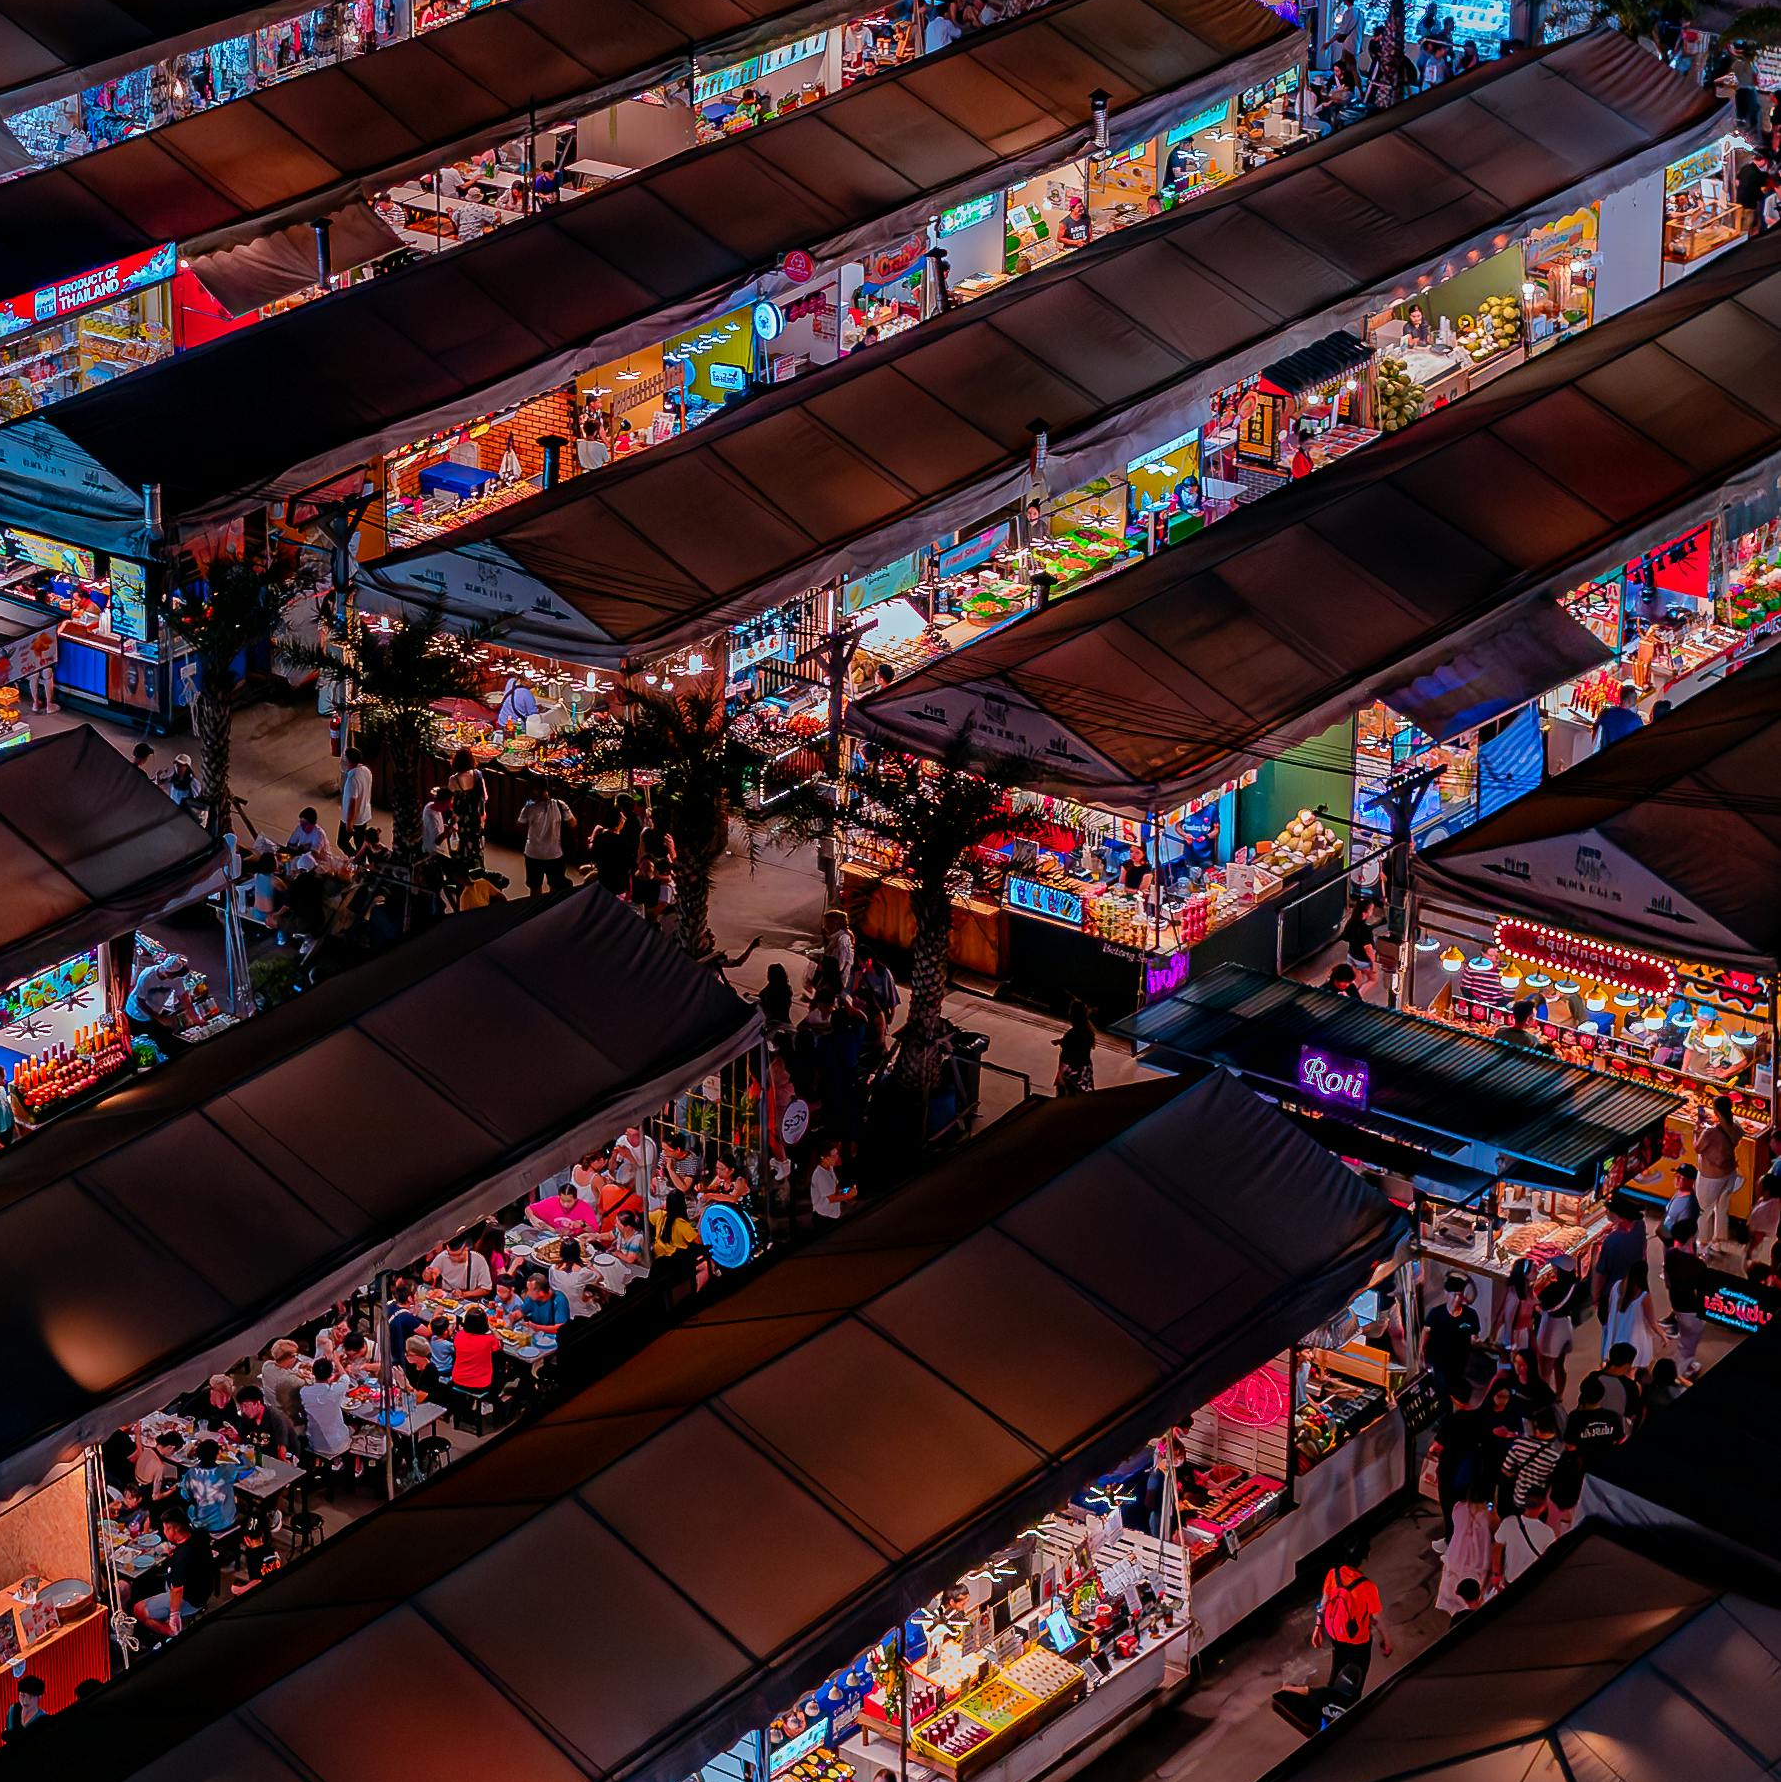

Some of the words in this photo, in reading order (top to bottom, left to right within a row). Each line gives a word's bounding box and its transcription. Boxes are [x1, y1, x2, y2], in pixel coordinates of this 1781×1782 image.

[58, 273, 103, 297] PRODUCT
[104, 265, 120, 279] OF
[58, 279, 120, 311] THAILAND
[1303, 1057, 1364, 1098] Roti
